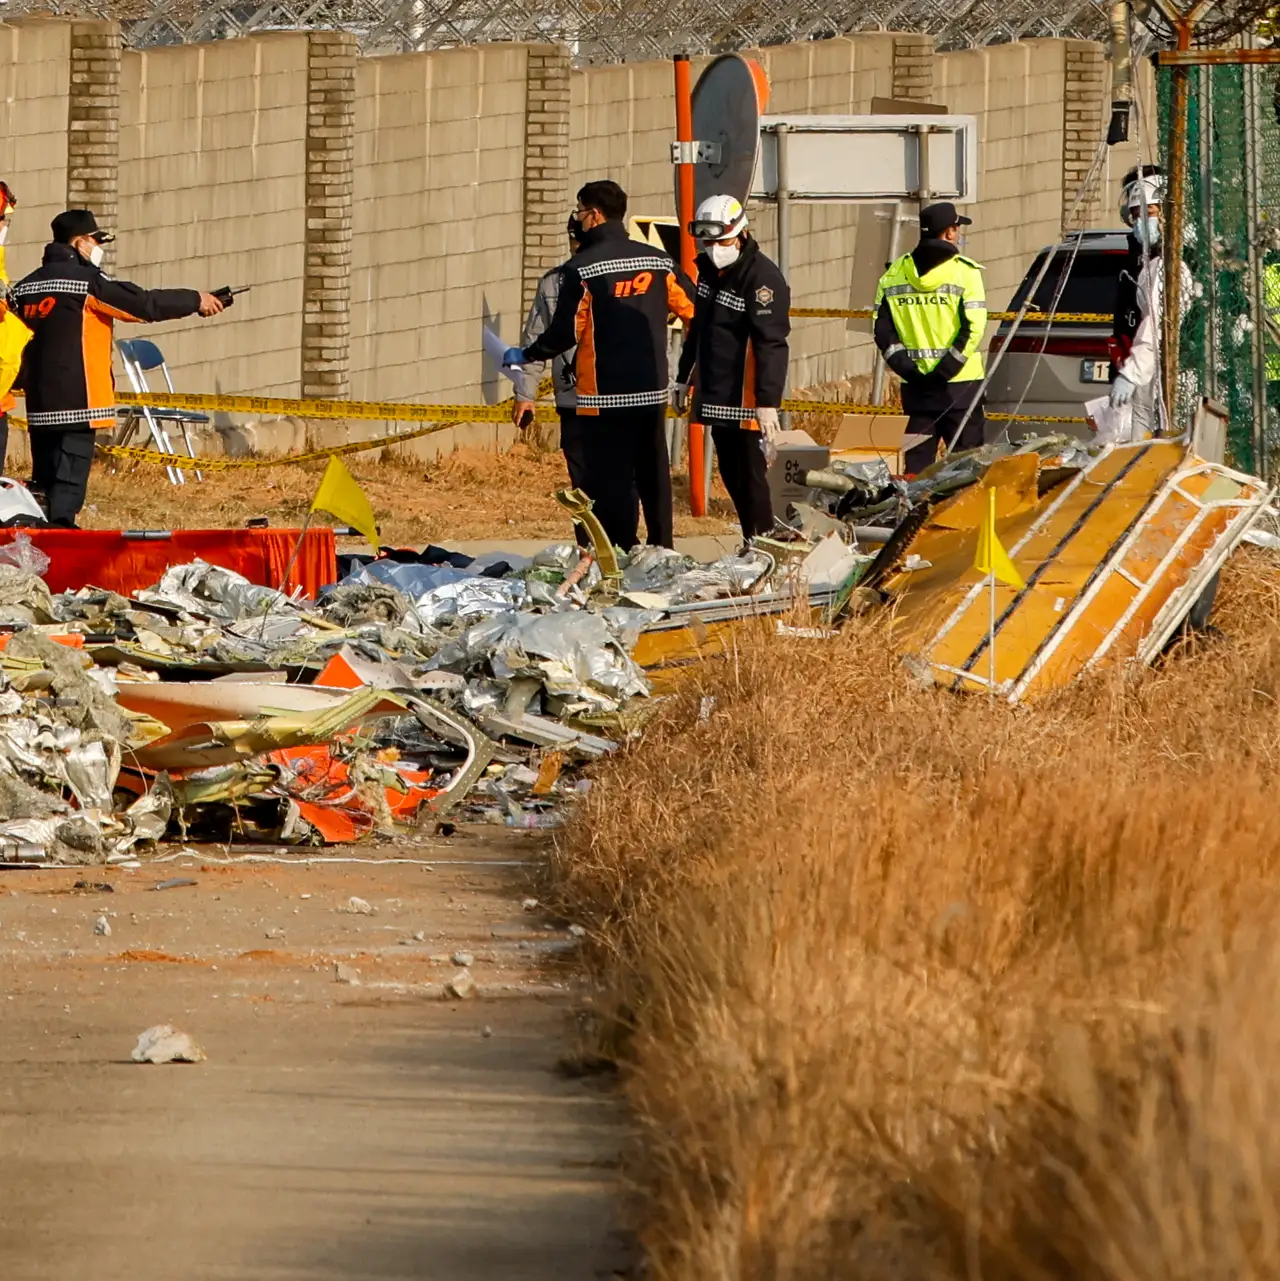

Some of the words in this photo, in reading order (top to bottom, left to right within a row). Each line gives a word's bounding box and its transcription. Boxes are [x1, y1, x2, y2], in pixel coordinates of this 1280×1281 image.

[613, 271, 653, 298] 119
[23, 296, 56, 319] 119
[897, 295, 948, 307] POLICE
